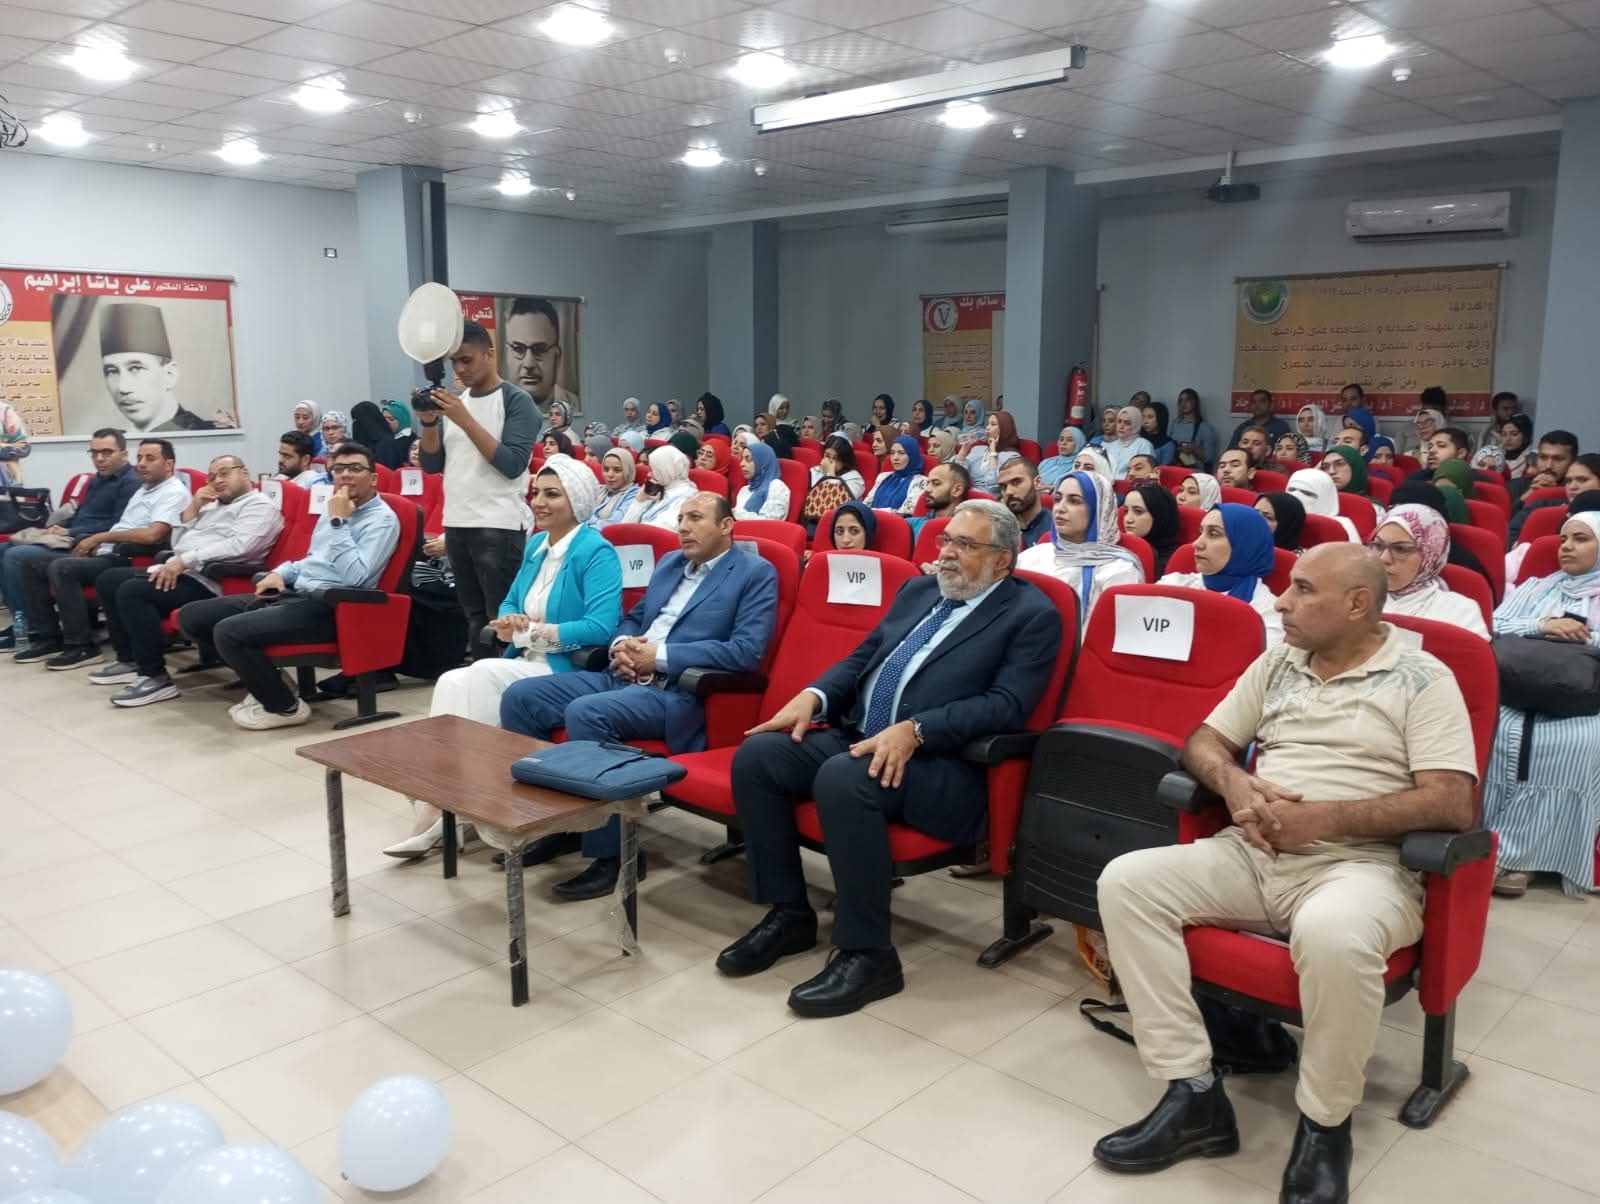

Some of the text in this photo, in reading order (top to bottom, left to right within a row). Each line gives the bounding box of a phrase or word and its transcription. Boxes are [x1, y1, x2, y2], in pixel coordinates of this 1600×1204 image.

[24, 273, 81, 292] إبراهيم
[86, 274, 120, 295] باشا
[124, 277, 151, 294] على
[629, 560, 644, 570] VIP
[846, 571, 866, 583] VIP
[1143, 617, 1170, 632] VIP
